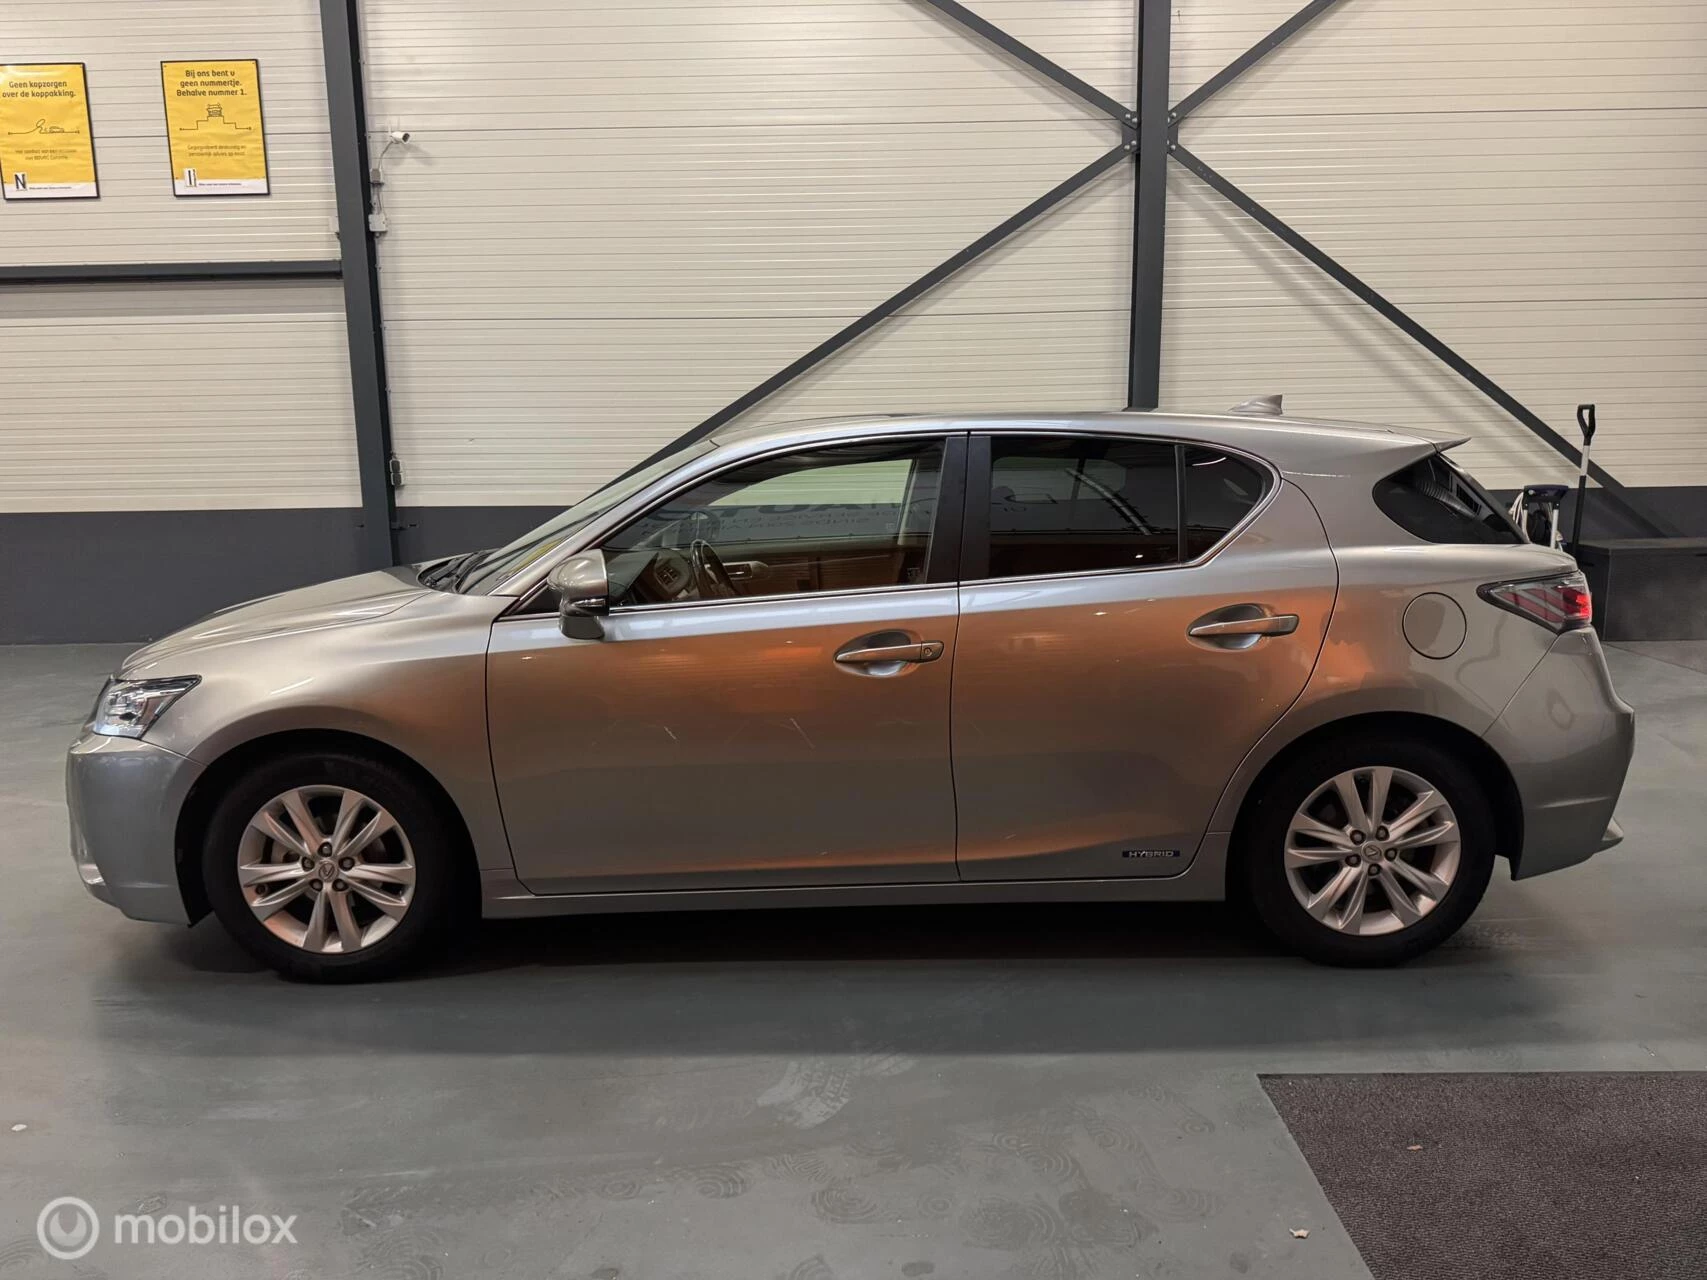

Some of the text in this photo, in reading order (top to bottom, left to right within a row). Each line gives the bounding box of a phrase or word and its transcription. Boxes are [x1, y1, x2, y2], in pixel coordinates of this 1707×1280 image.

[185, 69, 196, 78] Bij
[212, 69, 229, 77] bent
[9, 81, 67, 89] Geen kopzorgen
[180, 79, 242, 88] geen nummertje.
[20, 90, 29, 98] de
[32, 90, 76, 98] koppakking.
[176, 89, 206, 97] Behalve
